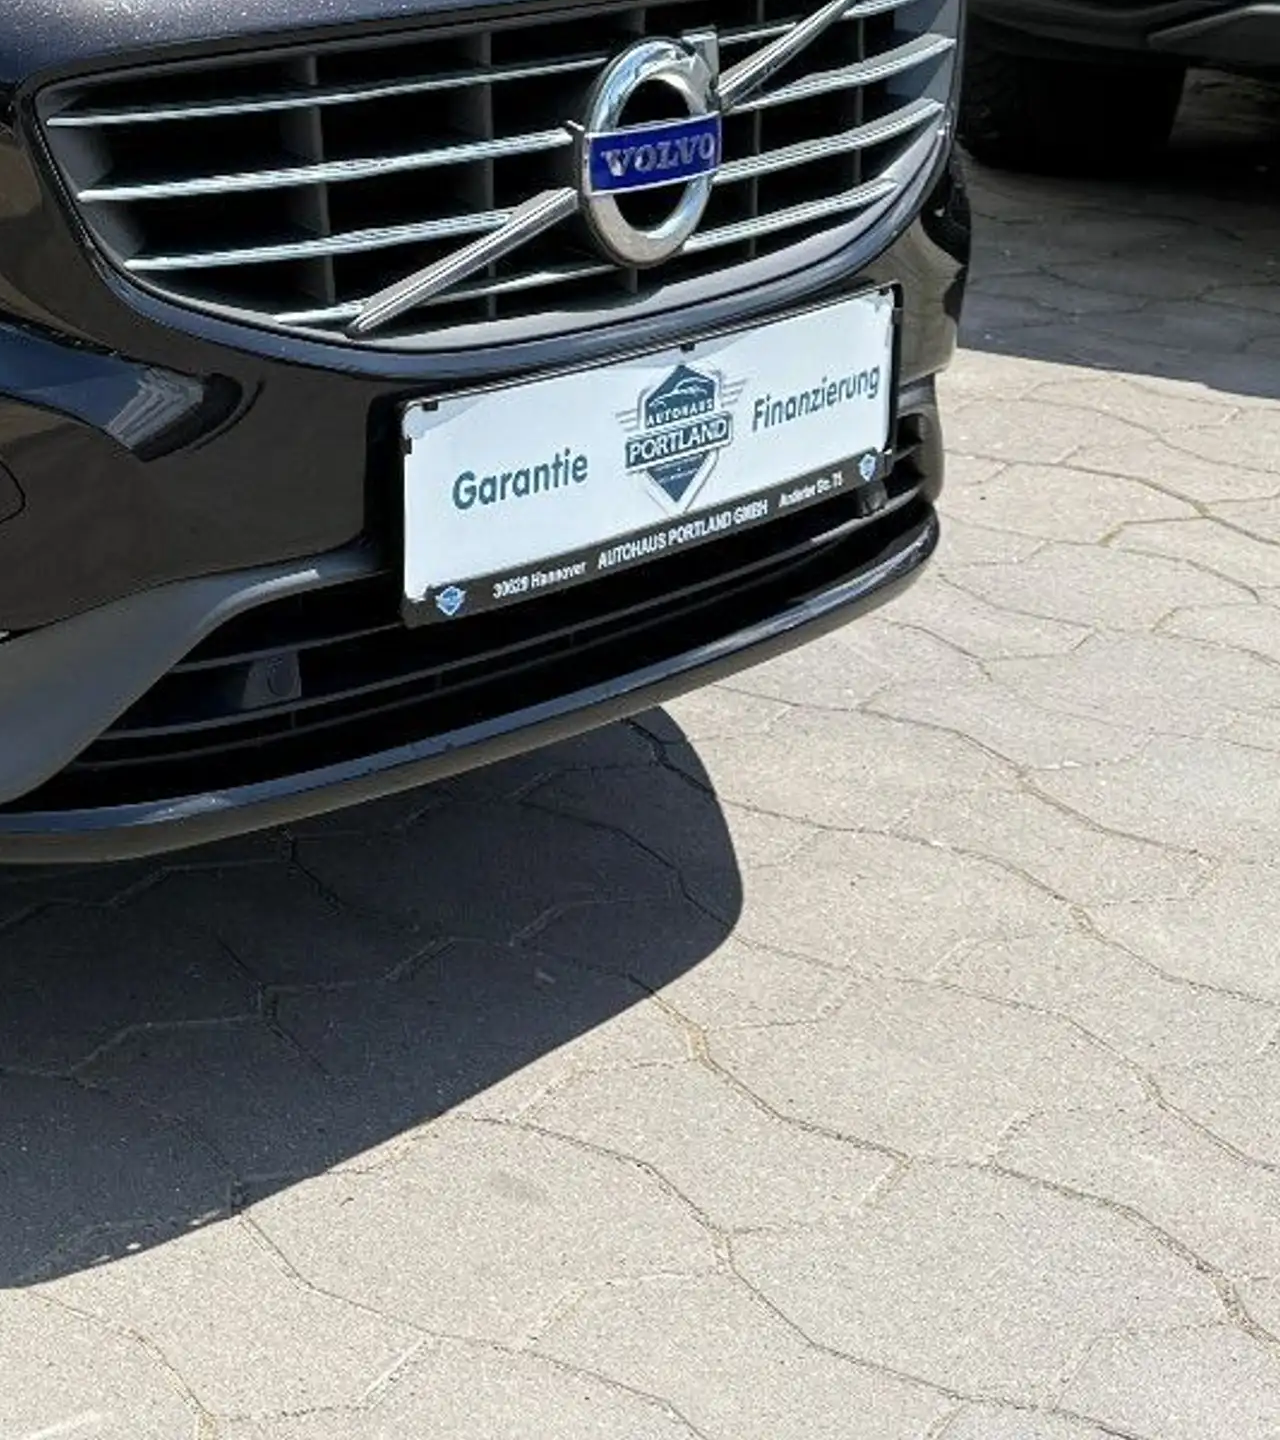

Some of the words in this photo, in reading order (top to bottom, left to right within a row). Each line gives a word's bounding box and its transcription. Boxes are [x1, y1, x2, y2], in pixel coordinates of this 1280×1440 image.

[599, 132, 716, 177] VOLVO
[645, 398, 714, 427] AUTOHAUS
[751, 364, 880, 433] Finanzierung
[629, 418, 727, 463] PORTLAND
[452, 447, 588, 510] Garantie
[597, 531, 667, 569] AUTOHAUS
[668, 510, 731, 548] PORTLAND
